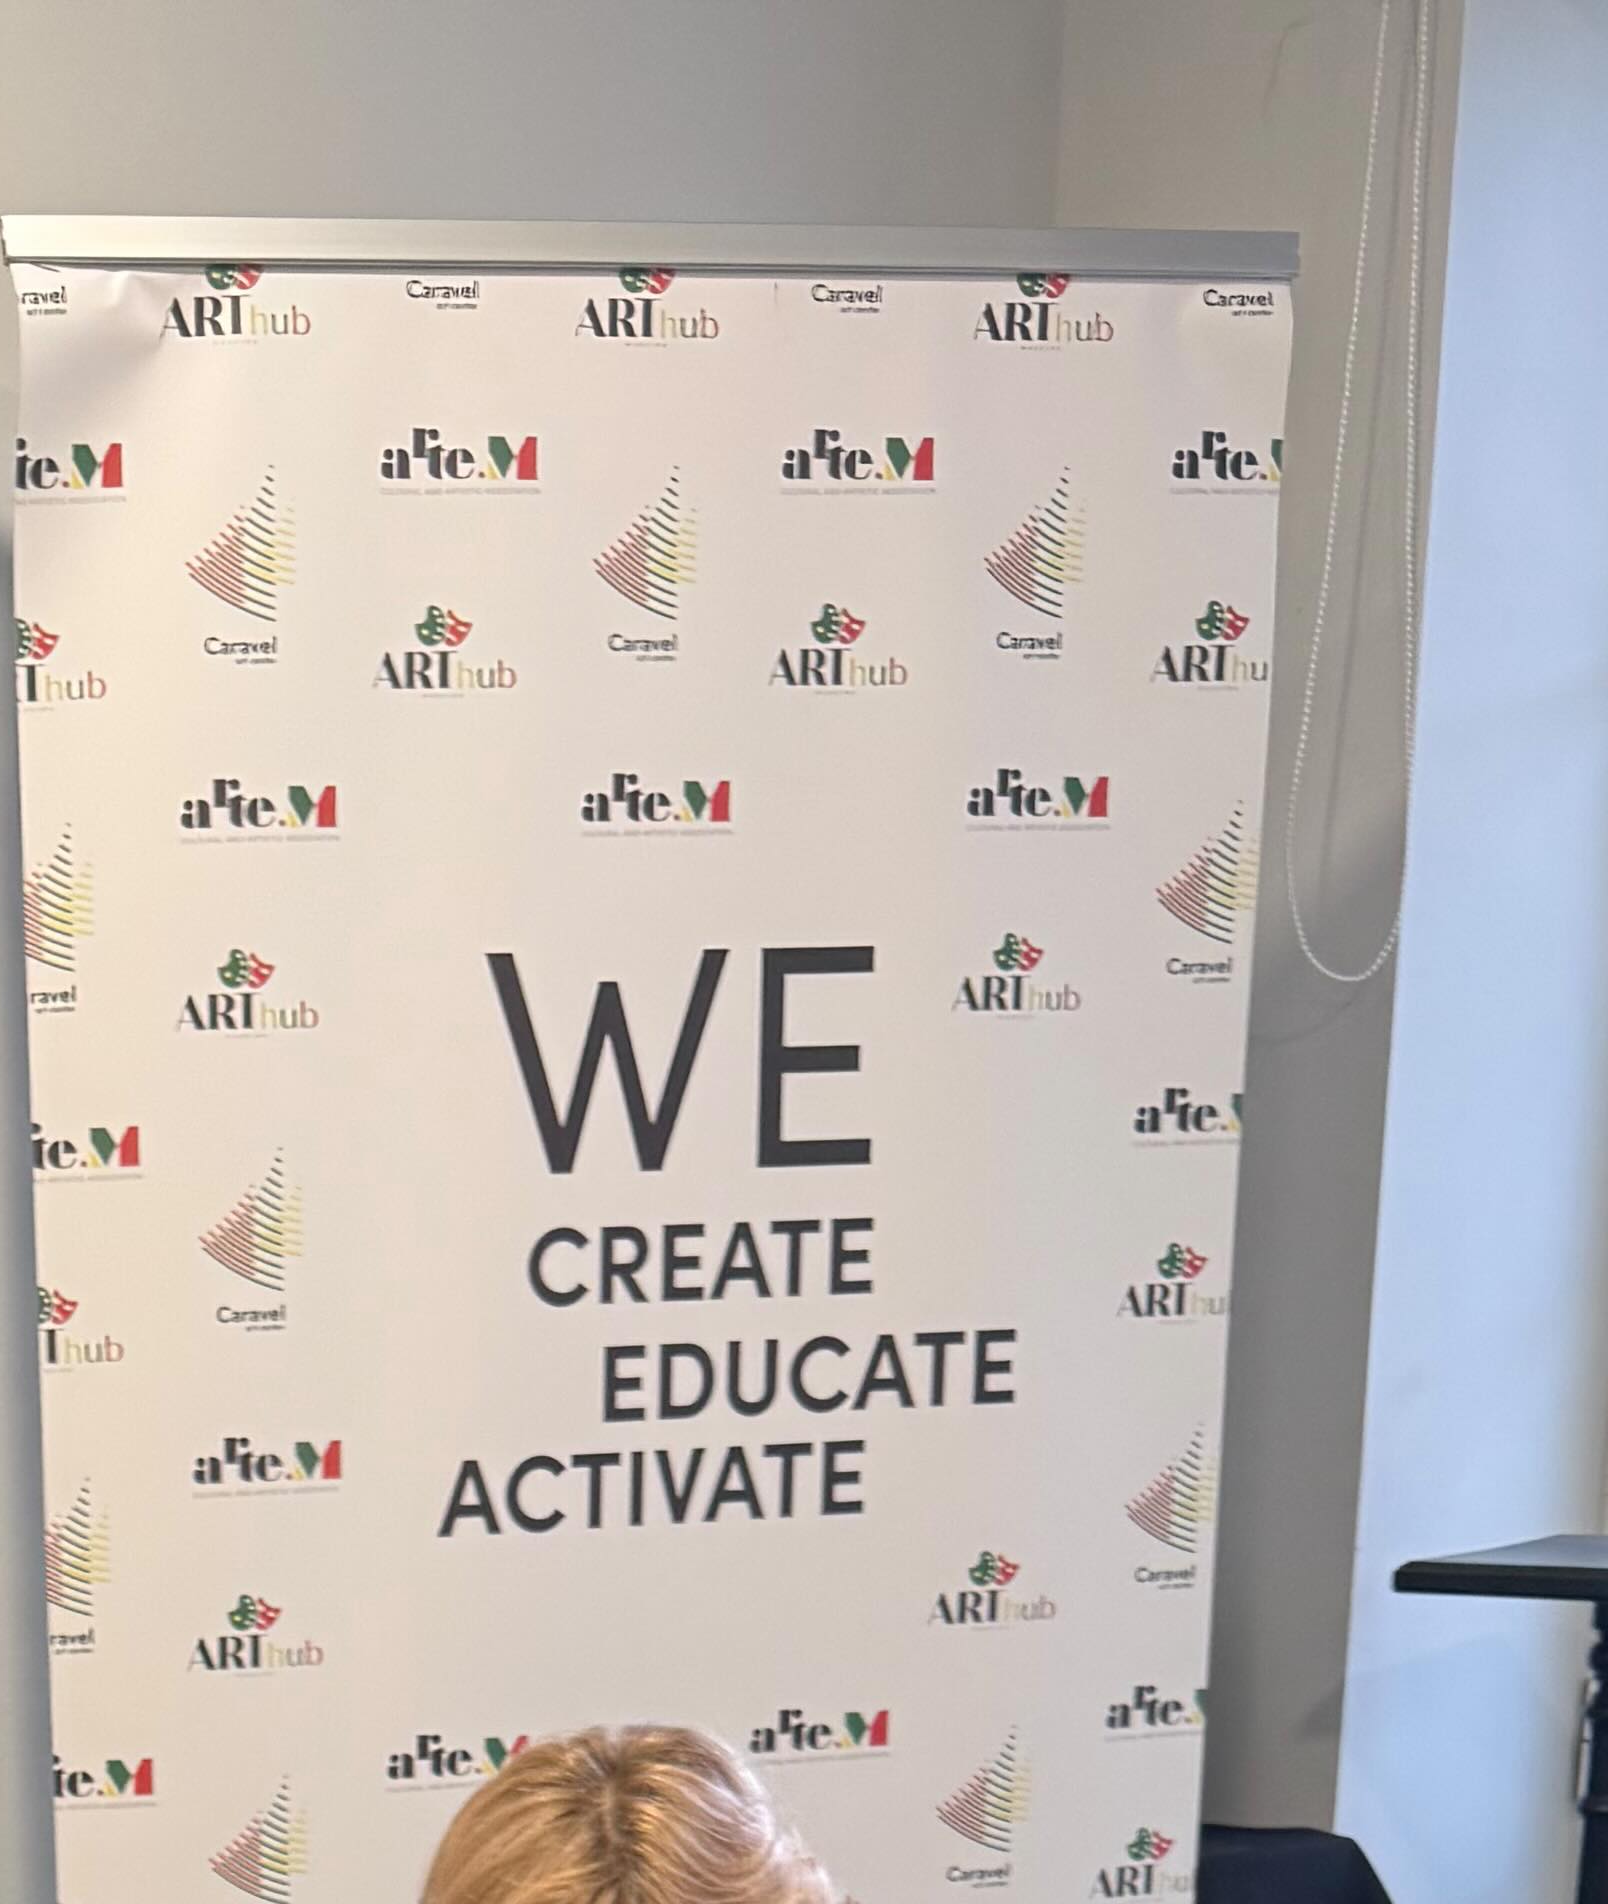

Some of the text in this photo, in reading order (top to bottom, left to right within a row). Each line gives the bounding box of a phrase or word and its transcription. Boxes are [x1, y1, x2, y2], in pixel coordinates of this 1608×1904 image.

[406, 280, 481, 302] Caravel
[812, 284, 883, 305] Caravel
[1203, 289, 1273, 309] Caravel
[204, 635, 277, 656] Caravel
[607, 633, 678, 655] Caravel
[996, 631, 1063, 652] Caravel
[1166, 957, 1233, 977] Caravel
[485, 946, 874, 1174] WE
[528, 1217, 874, 1307] CREATE
[216, 1304, 287, 1324] Caravel
[602, 1328, 1017, 1423] EDUCATE
[437, 1439, 865, 1538] ACTIVATE
[1134, 1565, 1196, 1584] Caravel
[946, 1863, 1011, 1883] Caravel
